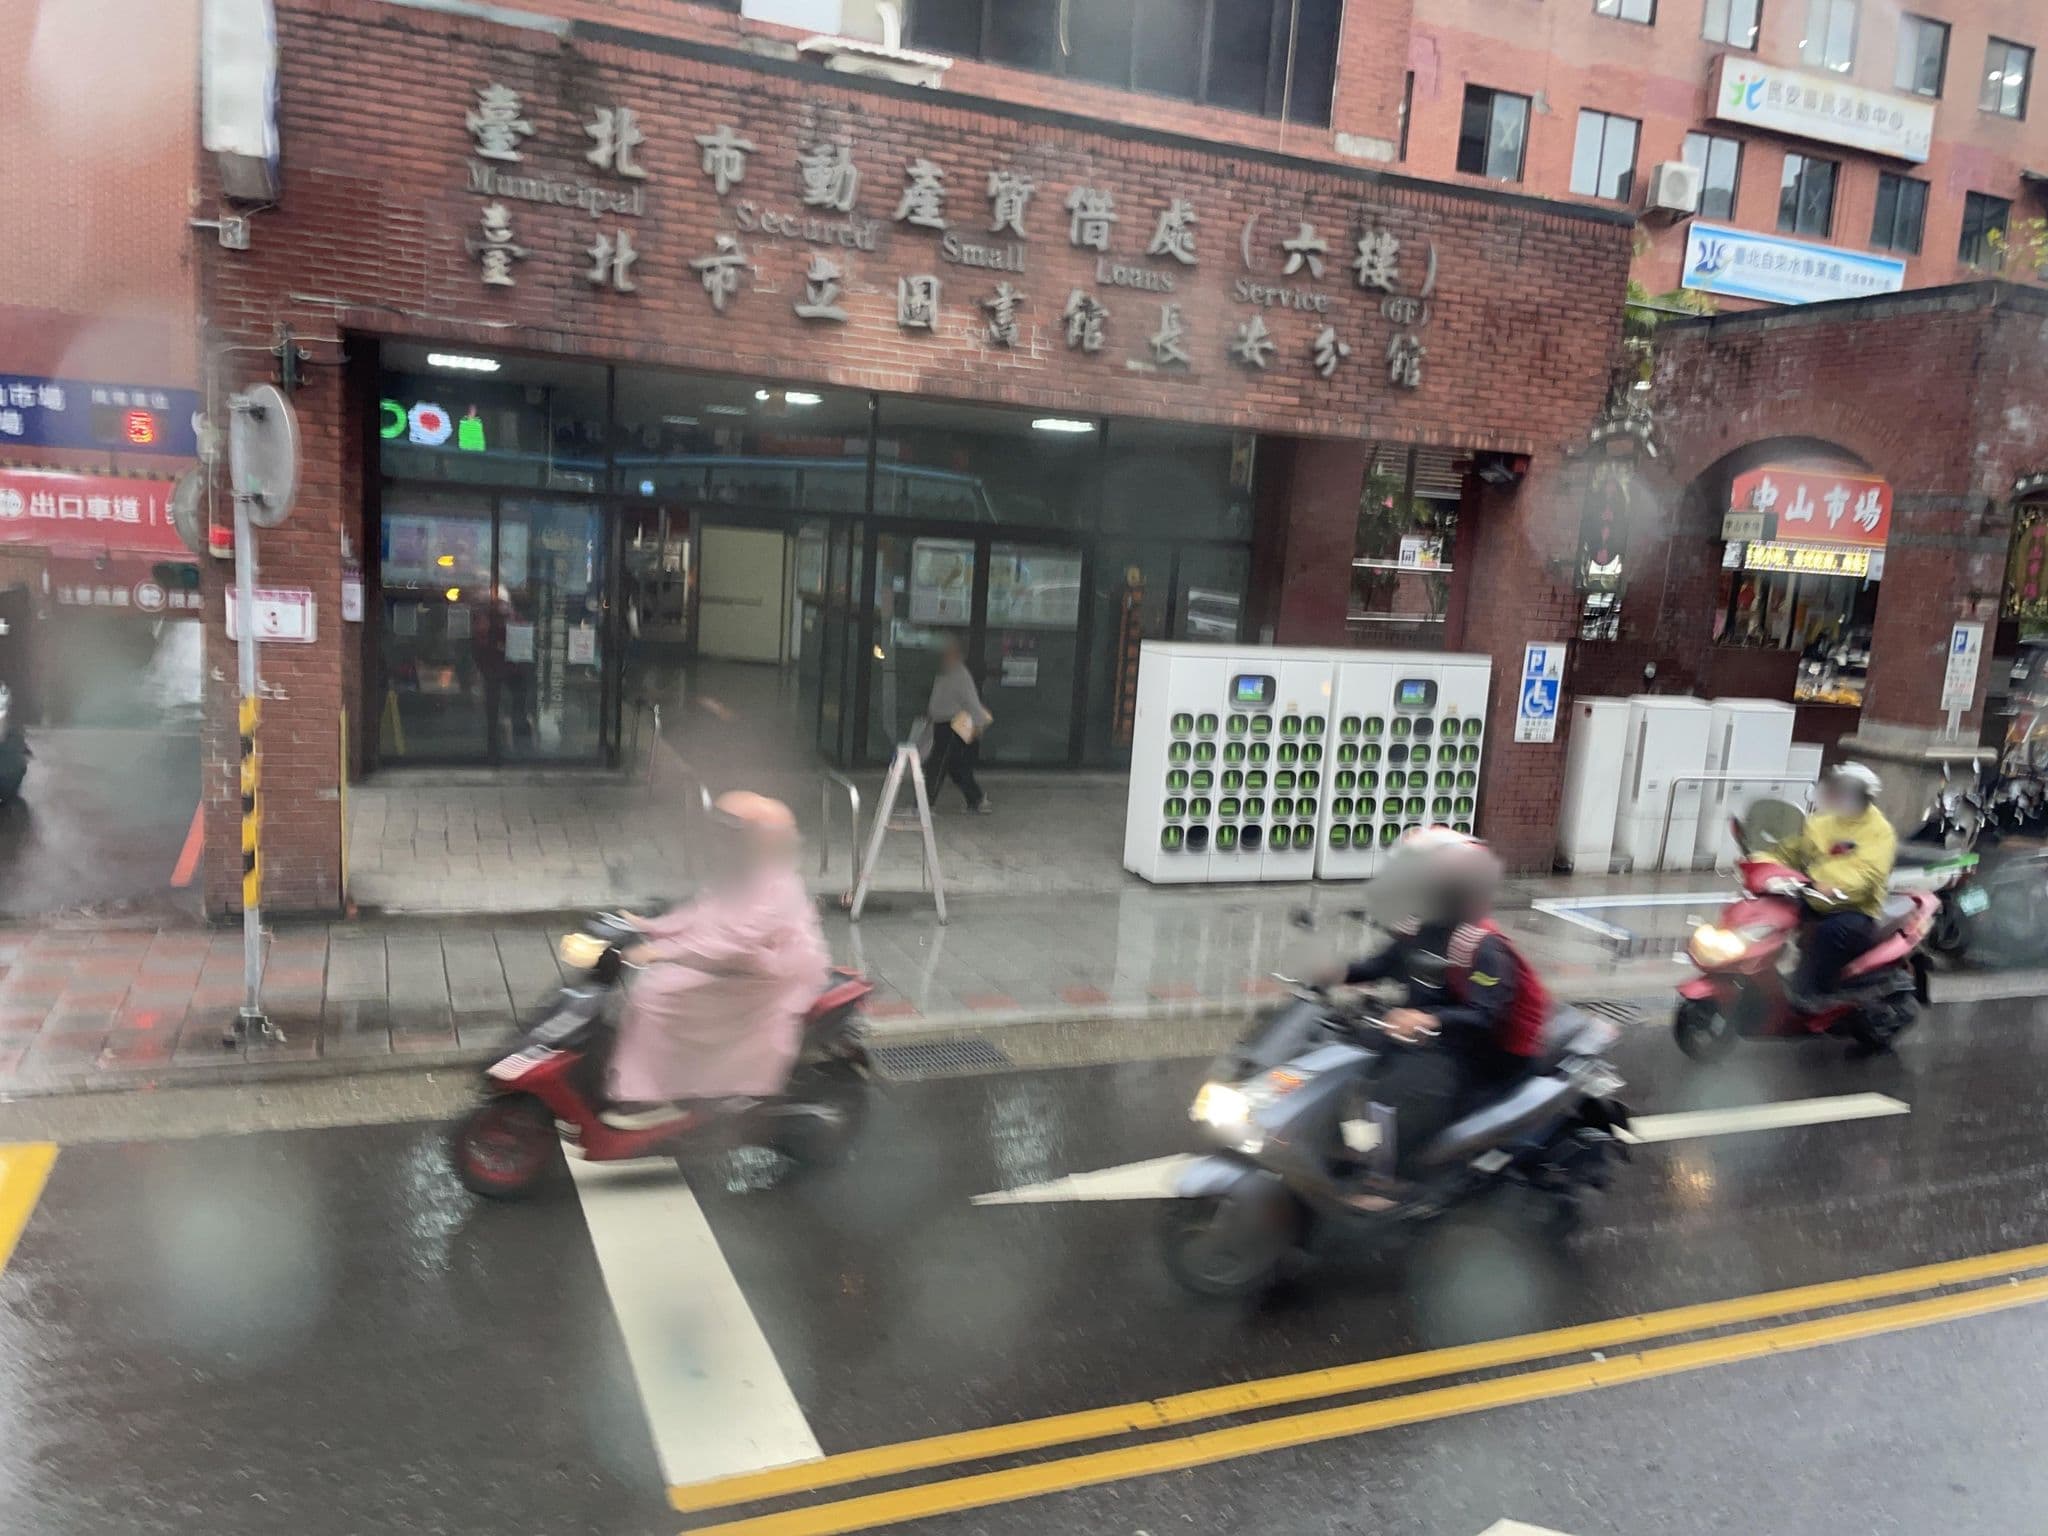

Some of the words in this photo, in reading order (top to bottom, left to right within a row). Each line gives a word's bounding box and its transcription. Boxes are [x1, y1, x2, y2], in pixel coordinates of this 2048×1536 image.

[466, 160, 645, 217] Municipal
[736, 200, 882, 250] Secured
[942, 230, 1026, 273] Small
[1096, 257, 1176, 292] Loans
[1234, 278, 1329, 313] Service
[465, 201, 1427, 388] 臺北市立圖書館長安分館
[29, 489, 141, 523] 出口車道
[1752, 474, 1883, 533] 中山市場
